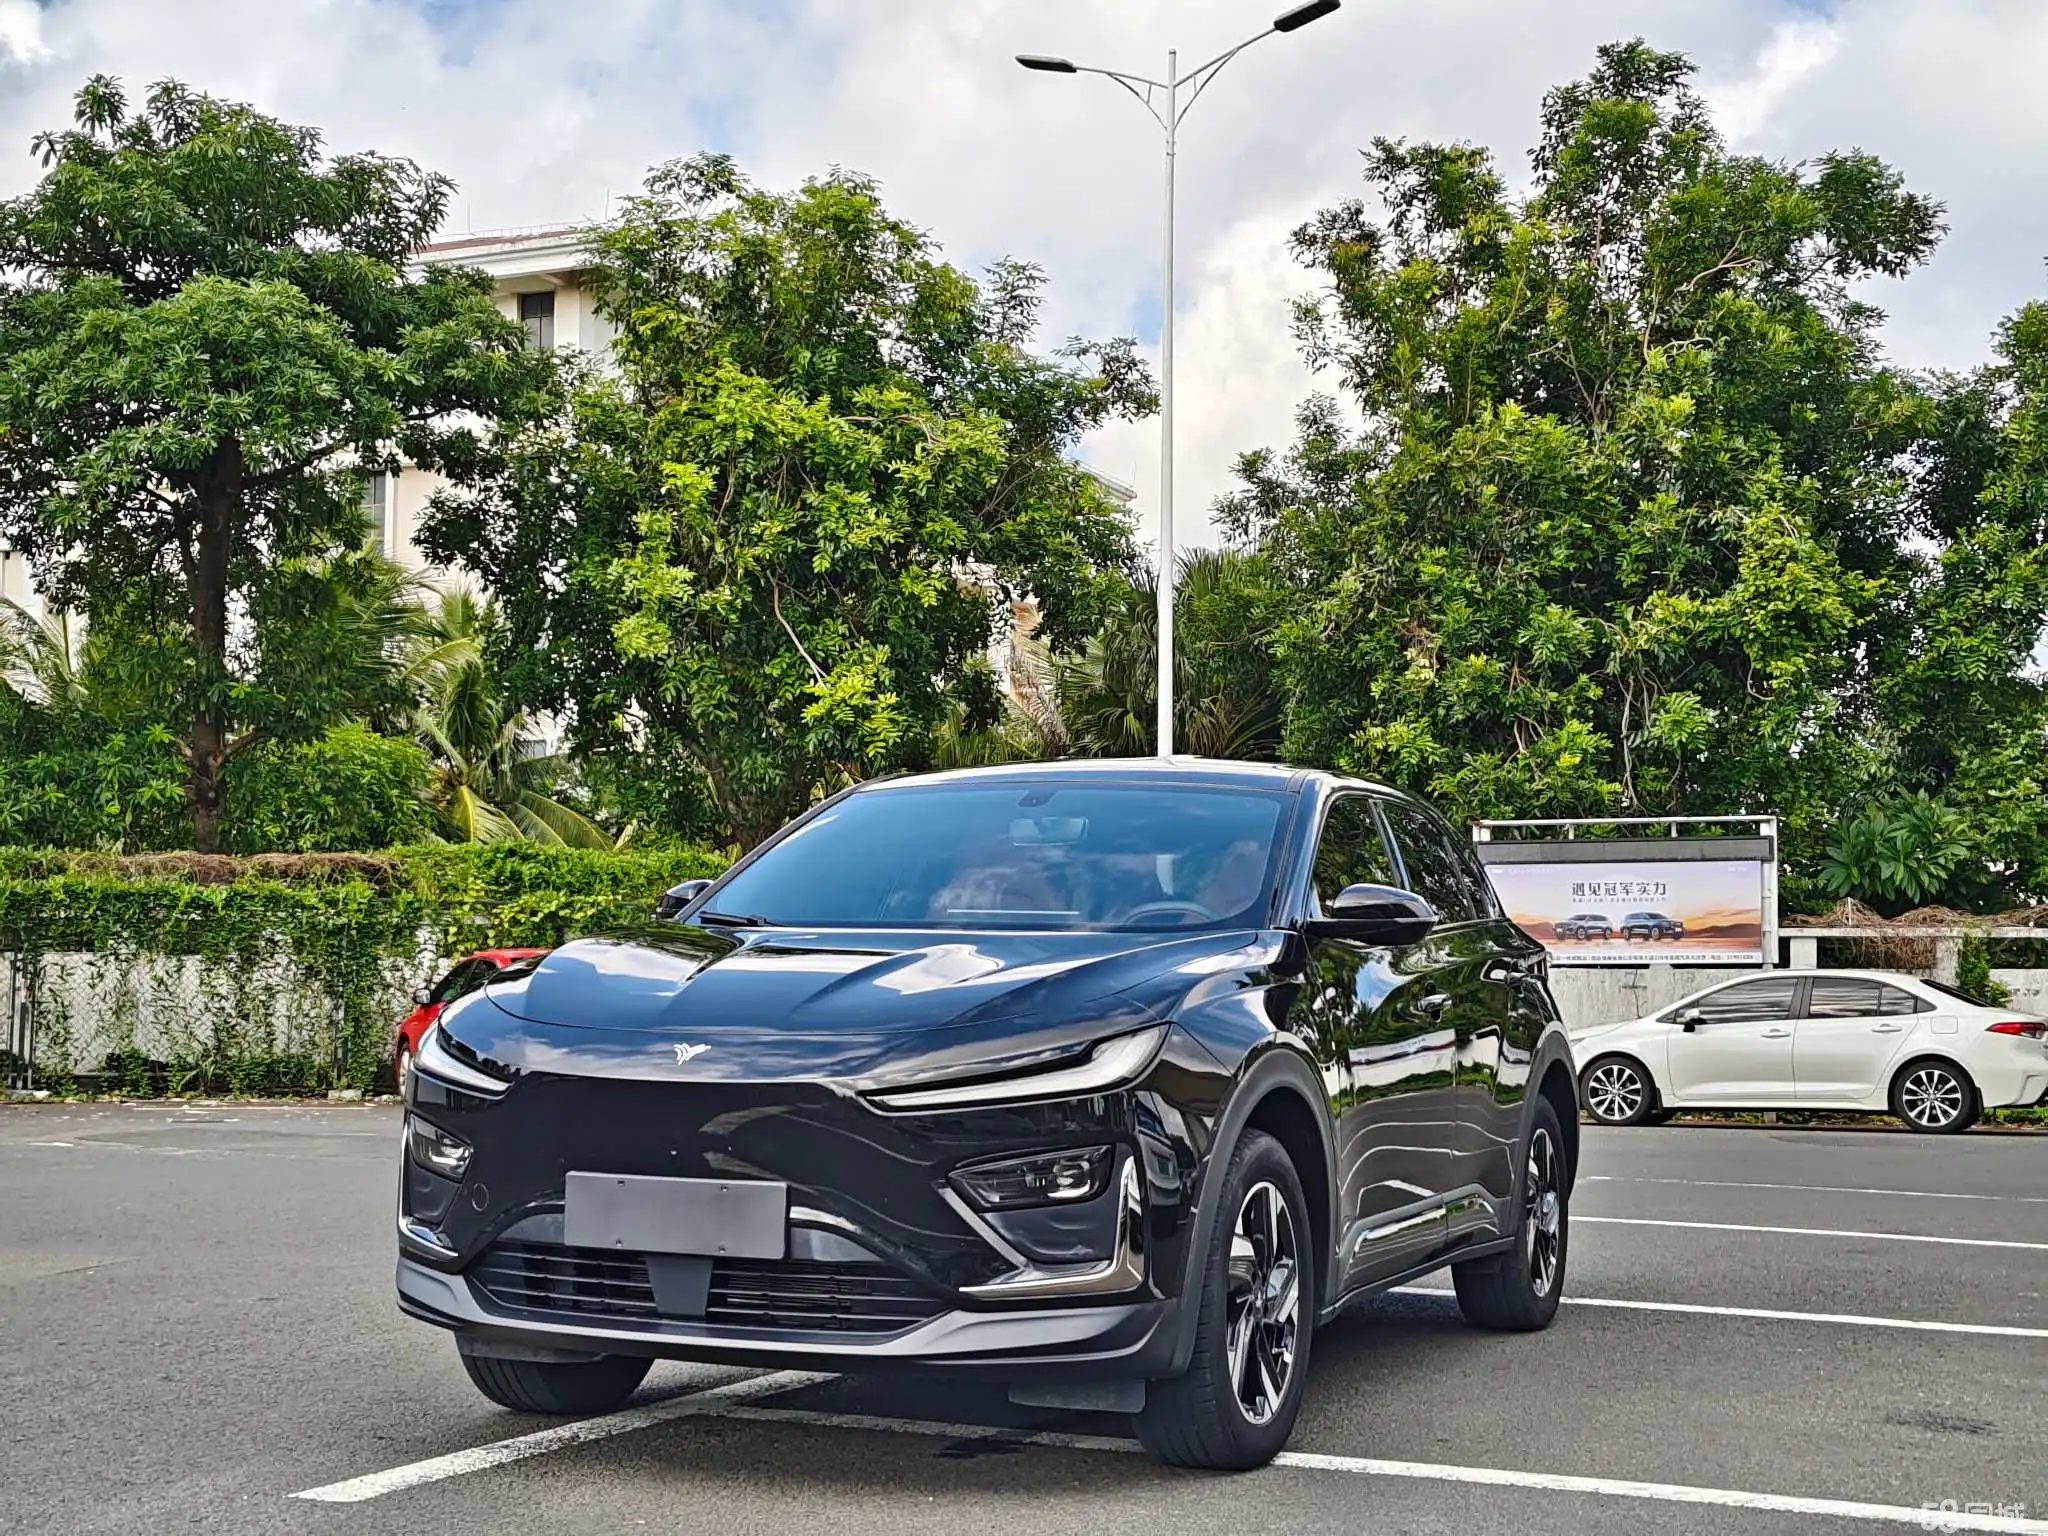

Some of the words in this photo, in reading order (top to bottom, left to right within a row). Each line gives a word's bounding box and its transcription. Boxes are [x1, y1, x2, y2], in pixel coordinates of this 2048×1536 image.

[1572, 882, 1667, 897] 遇见冠军实力
